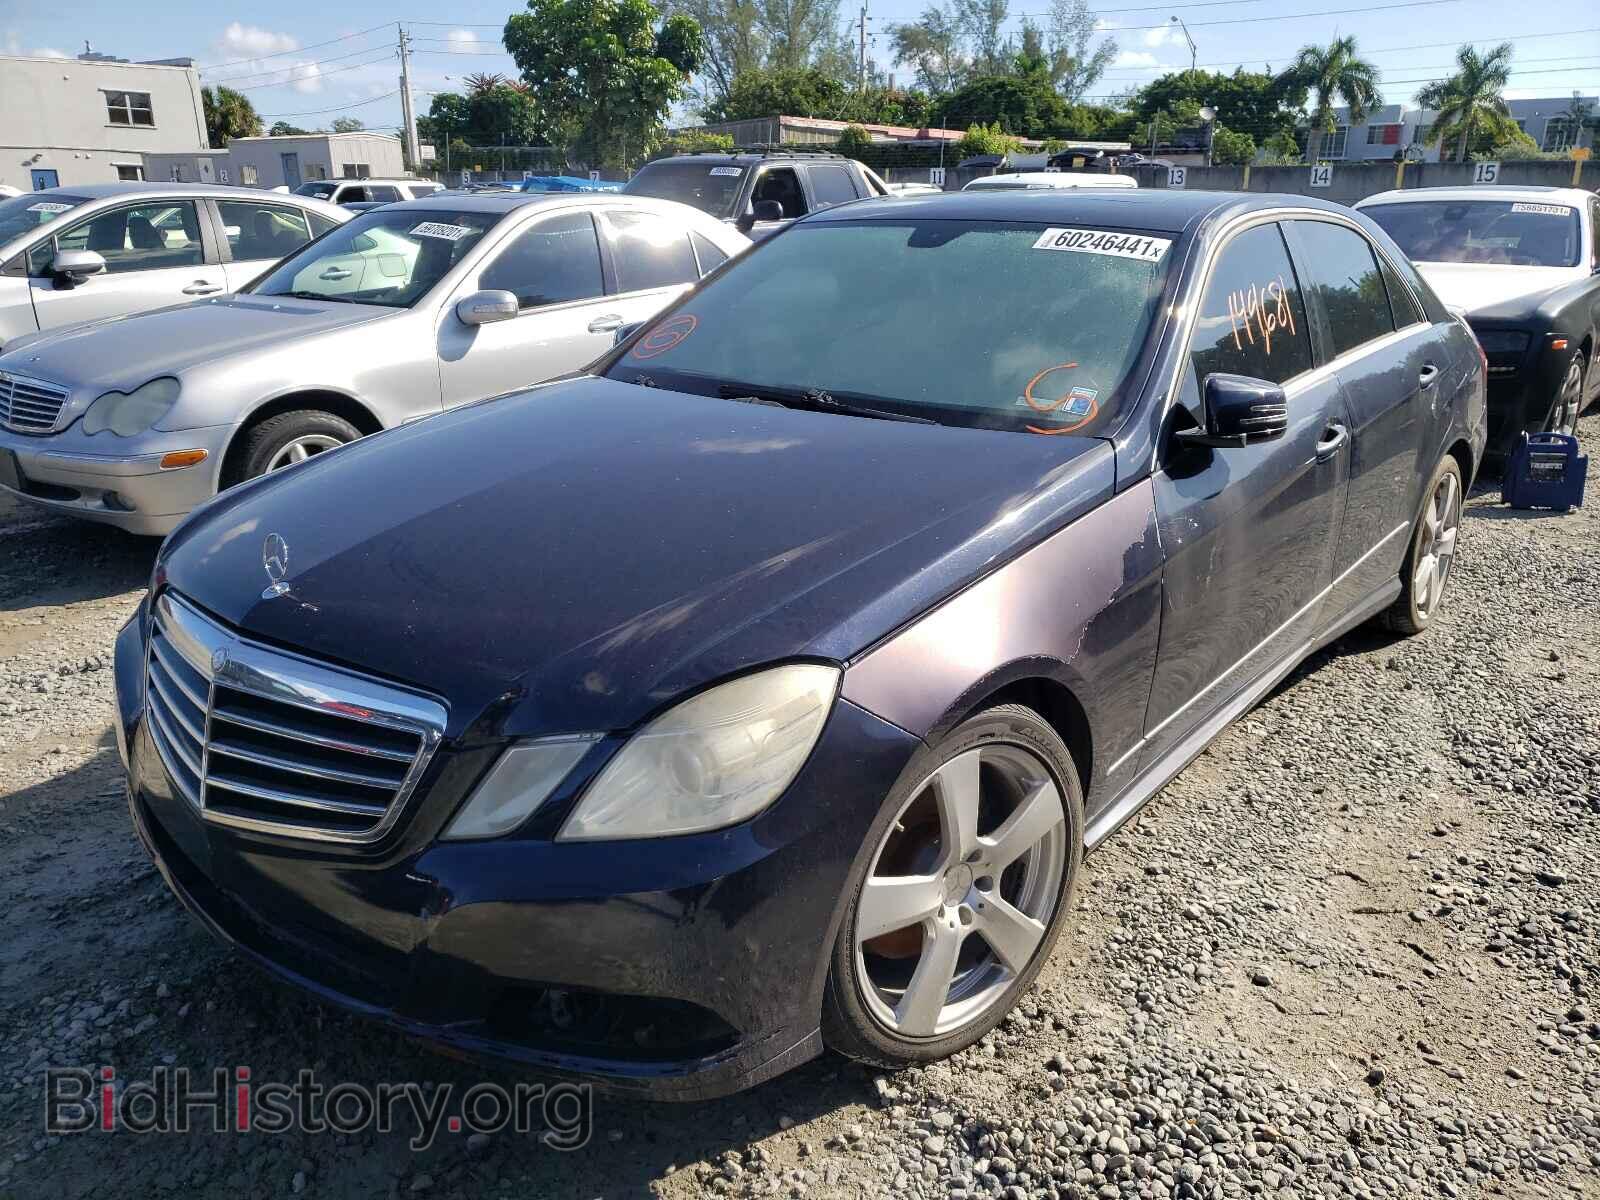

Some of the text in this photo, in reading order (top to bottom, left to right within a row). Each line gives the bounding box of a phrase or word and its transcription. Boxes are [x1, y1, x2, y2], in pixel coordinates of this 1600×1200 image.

[932, 170, 942, 184] 11
[1169, 169, 1185, 185] 13
[1312, 167, 1329, 185] 14
[1475, 164, 1496, 182] 15
